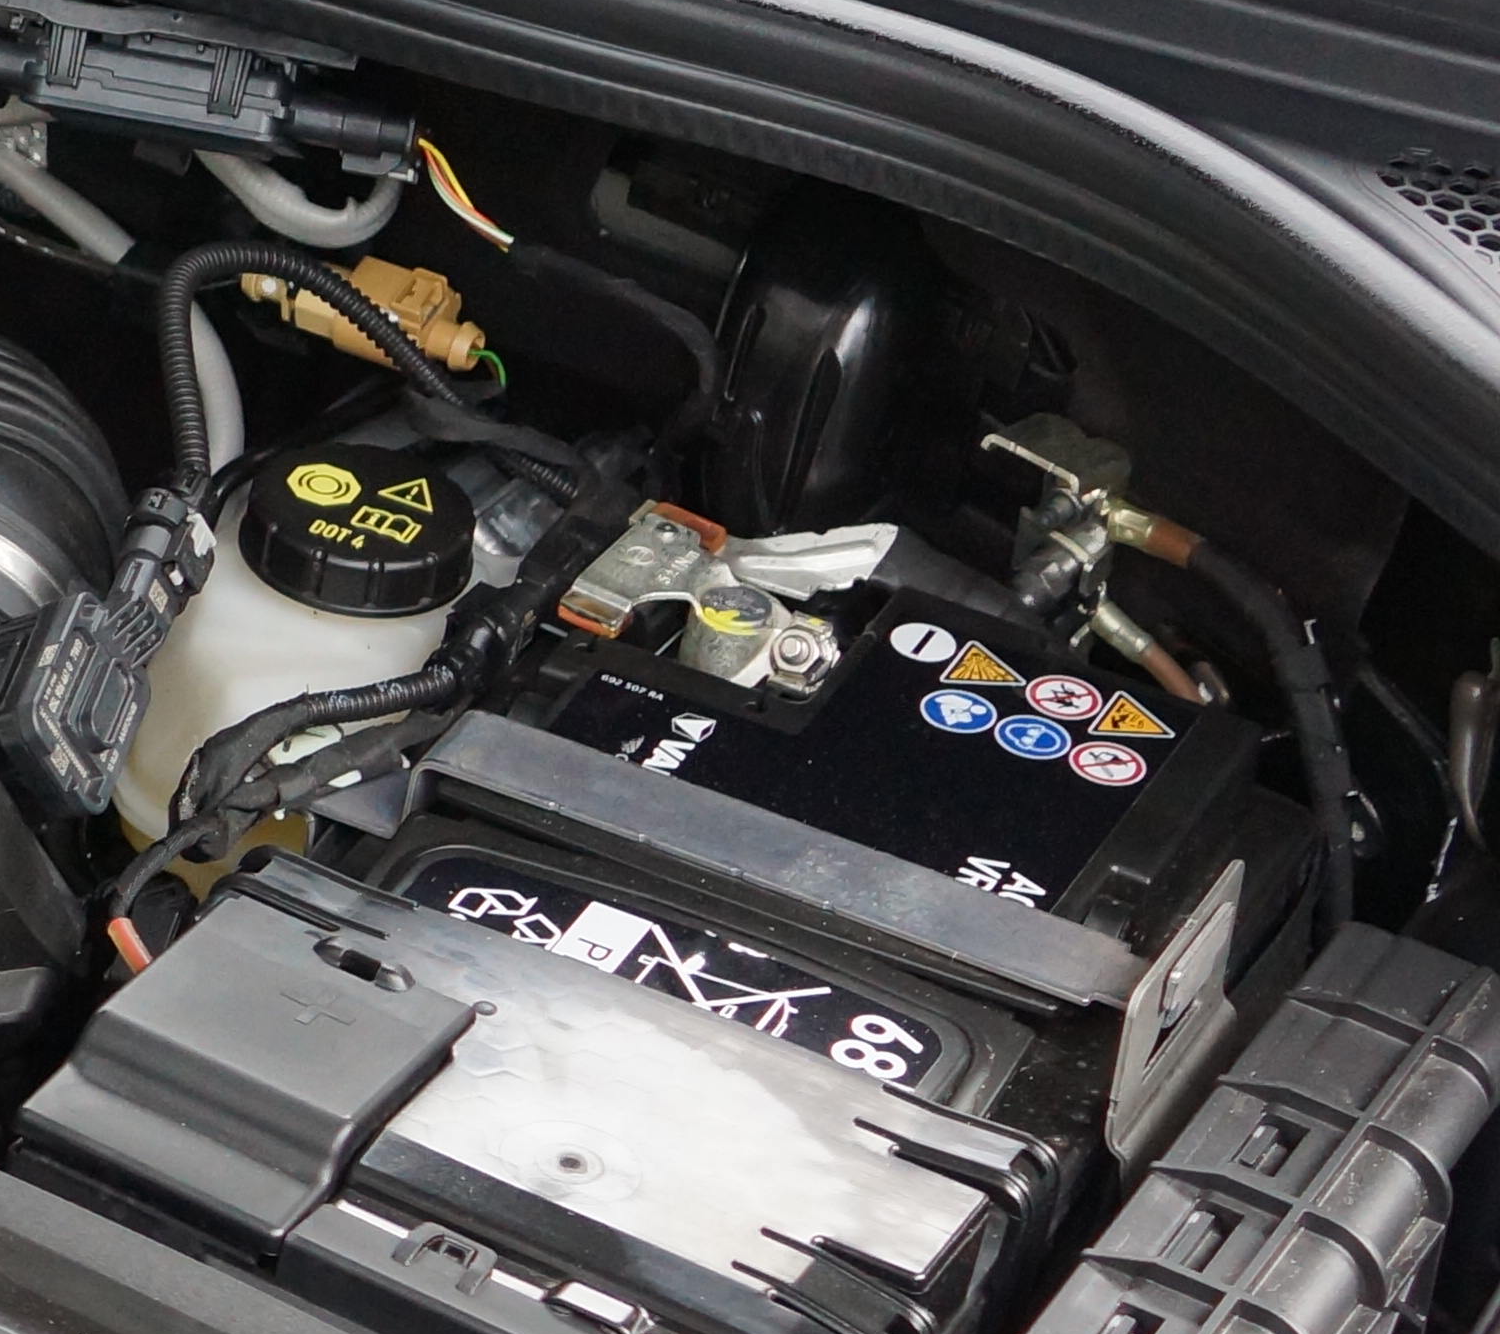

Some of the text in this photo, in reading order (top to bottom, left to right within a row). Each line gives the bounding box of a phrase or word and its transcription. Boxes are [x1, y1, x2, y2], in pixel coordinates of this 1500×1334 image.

[309, 517, 365, 550] DOT 4
[601, 673, 624, 687] 692
[624, 681, 647, 694] 507
[830, 1013, 924, 1079] 68
